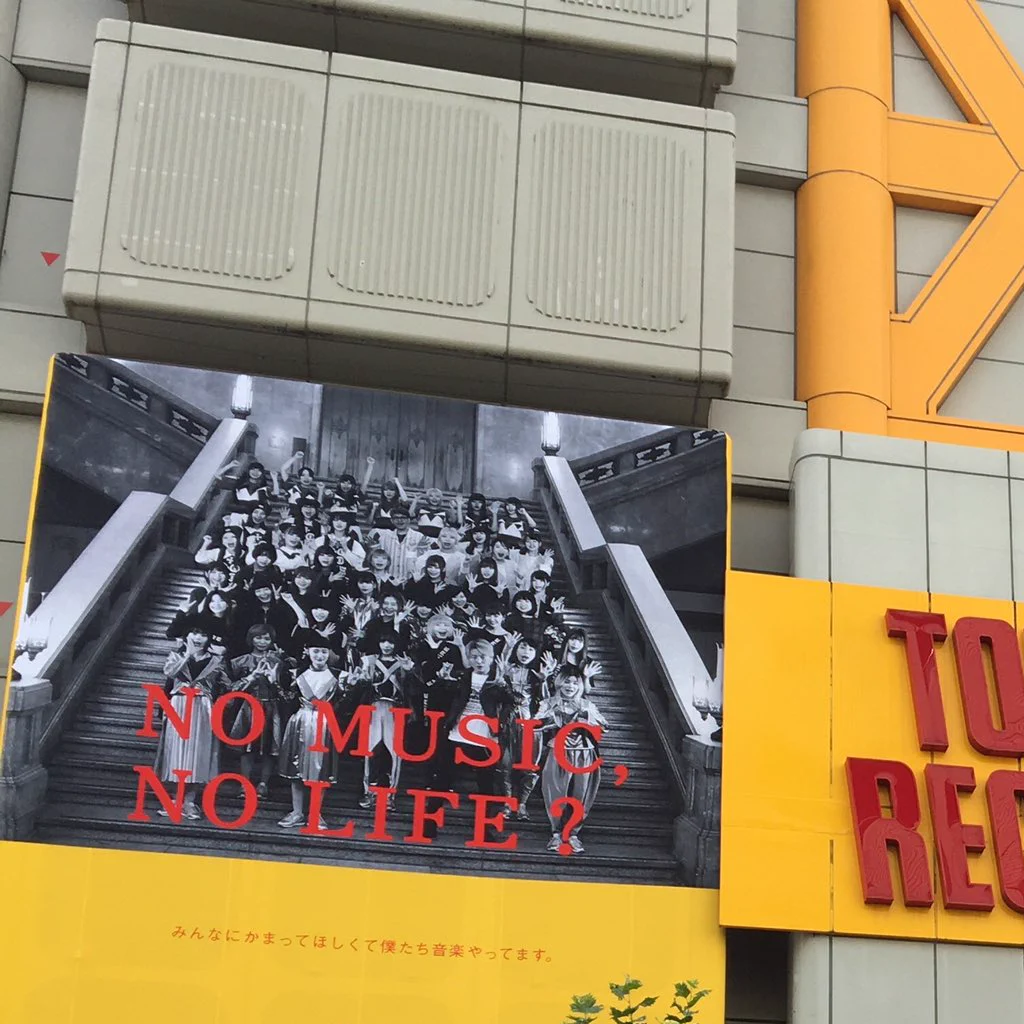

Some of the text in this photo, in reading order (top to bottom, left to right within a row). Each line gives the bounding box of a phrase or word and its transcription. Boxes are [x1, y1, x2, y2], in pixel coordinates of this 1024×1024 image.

[136, 684, 630, 786] NO MUSIC,
[127, 766, 260, 829] NO
[303, 779, 519, 851] LIFE
[171, 925, 553, 964] みんなにかまってほしくて僕たち音楽やってます。
